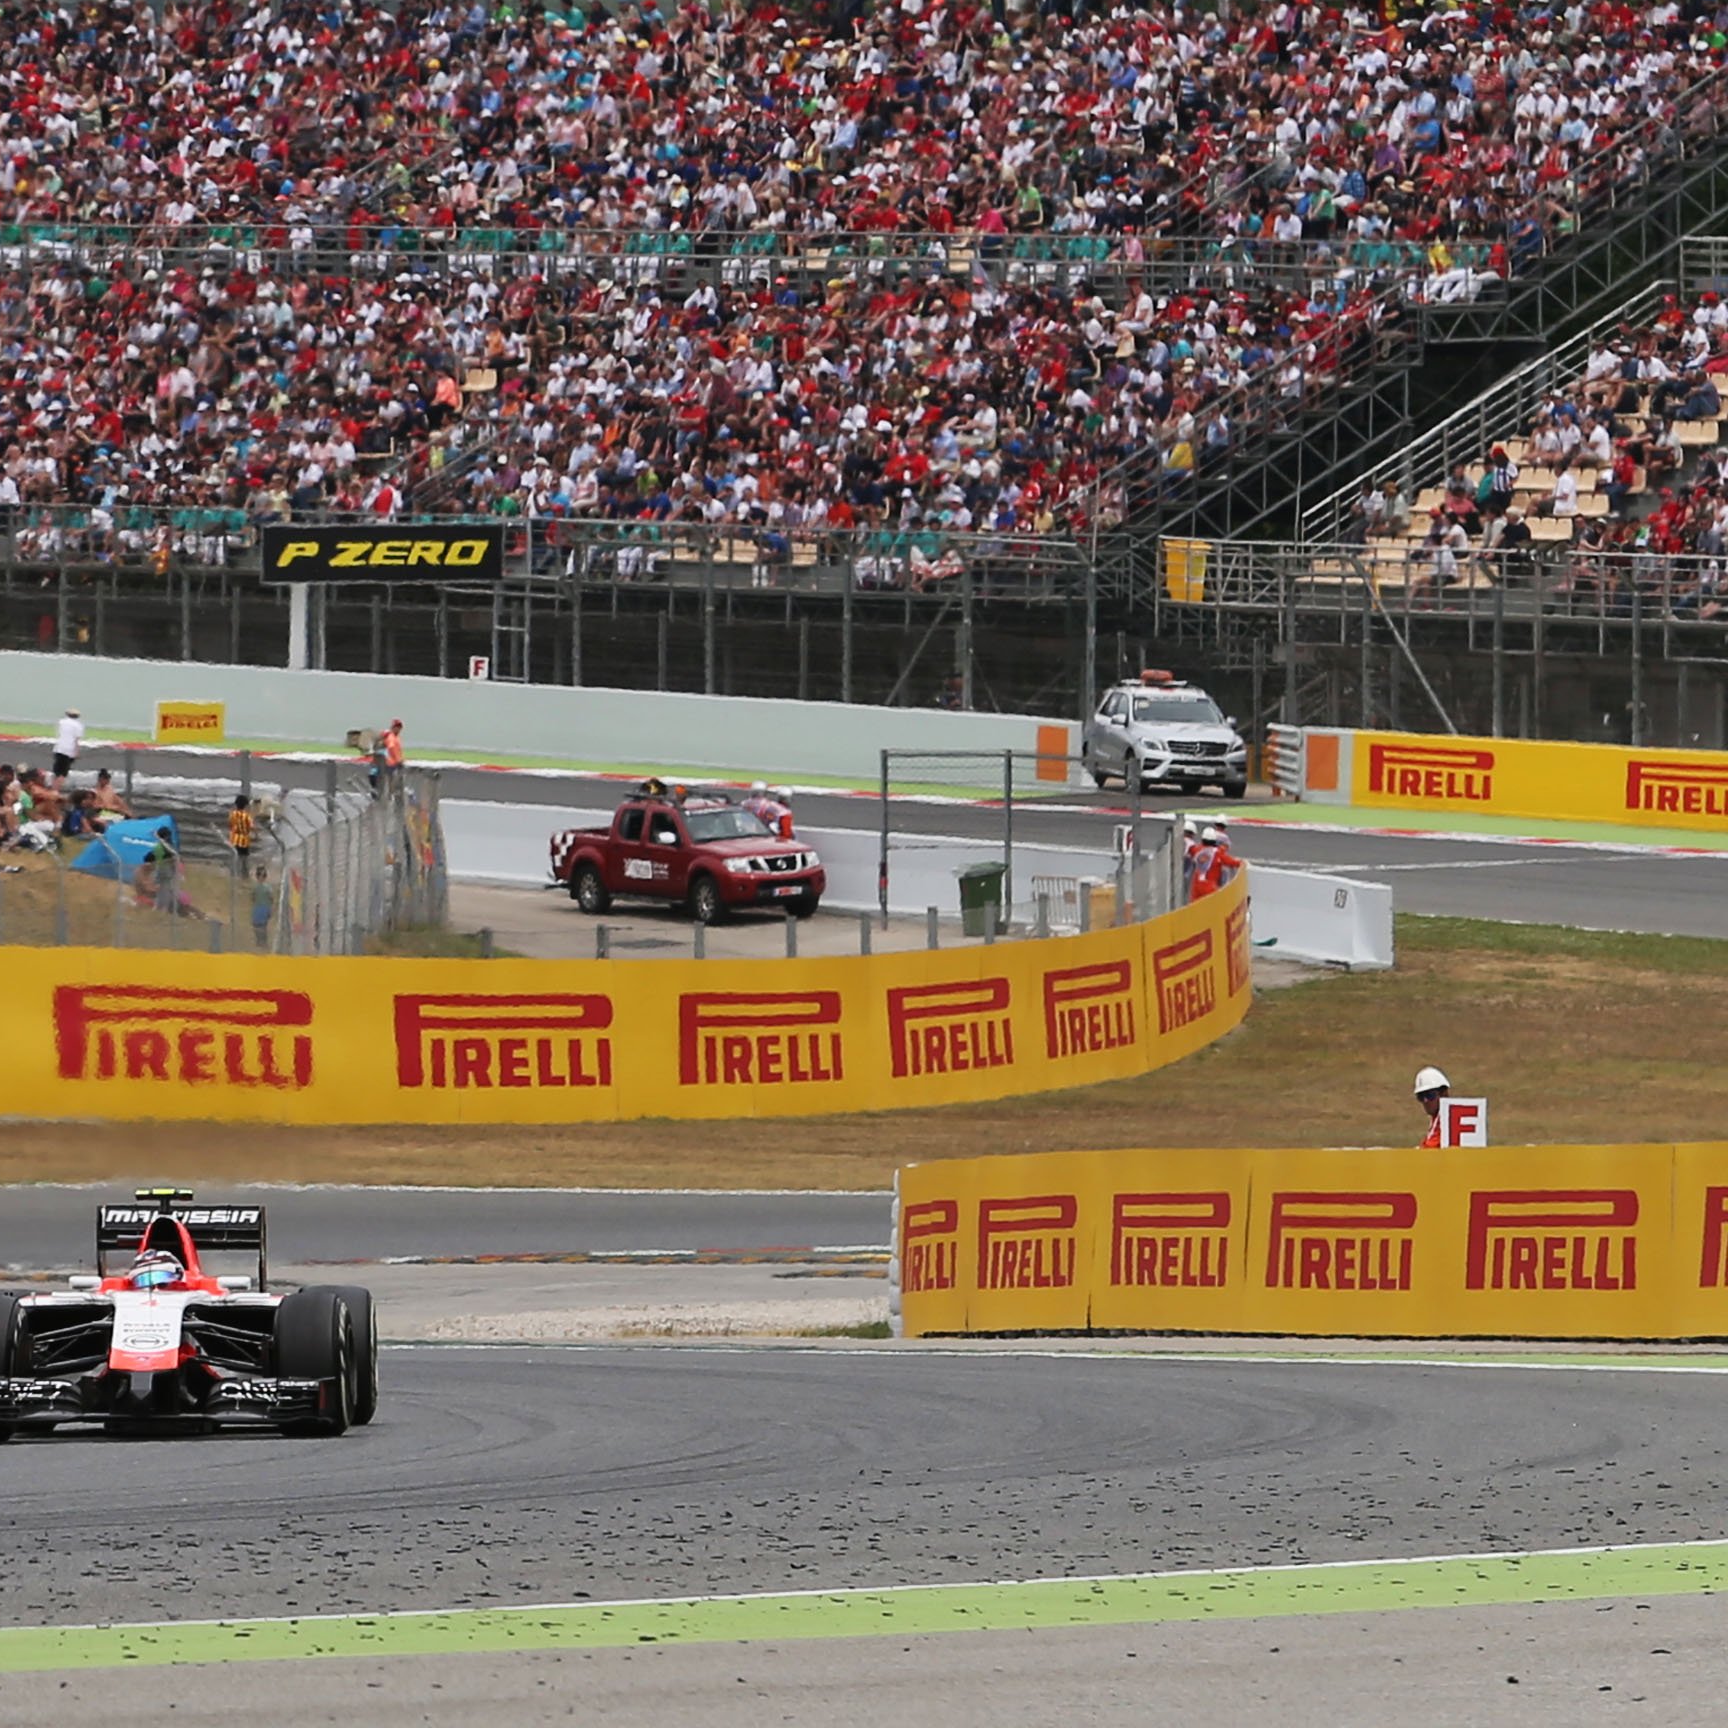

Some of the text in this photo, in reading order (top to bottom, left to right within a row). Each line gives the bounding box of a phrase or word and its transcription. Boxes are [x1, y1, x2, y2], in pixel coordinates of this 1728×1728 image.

[277, 540, 489, 567] P ZERO
[474, 660, 485, 676] F
[1369, 743, 1494, 801] PIRELLI
[887, 977, 1014, 1078] PIRELLI
[1044, 959, 1136, 1059] PIRELLI
[1152, 928, 1215, 1035] PIRELLI
[53, 983, 315, 1089] PIRELLI
[393, 993, 613, 1088] PIRELLI
[678, 991, 843, 1086] PIRELLI
[1450, 1105, 1477, 1145] F
[978, 1195, 1078, 1290] PIRELLI
[1110, 1192, 1231, 1288] PIRELLI
[1265, 1192, 1417, 1291] PIRELLI
[1466, 1190, 1639, 1291] PIRELLI
